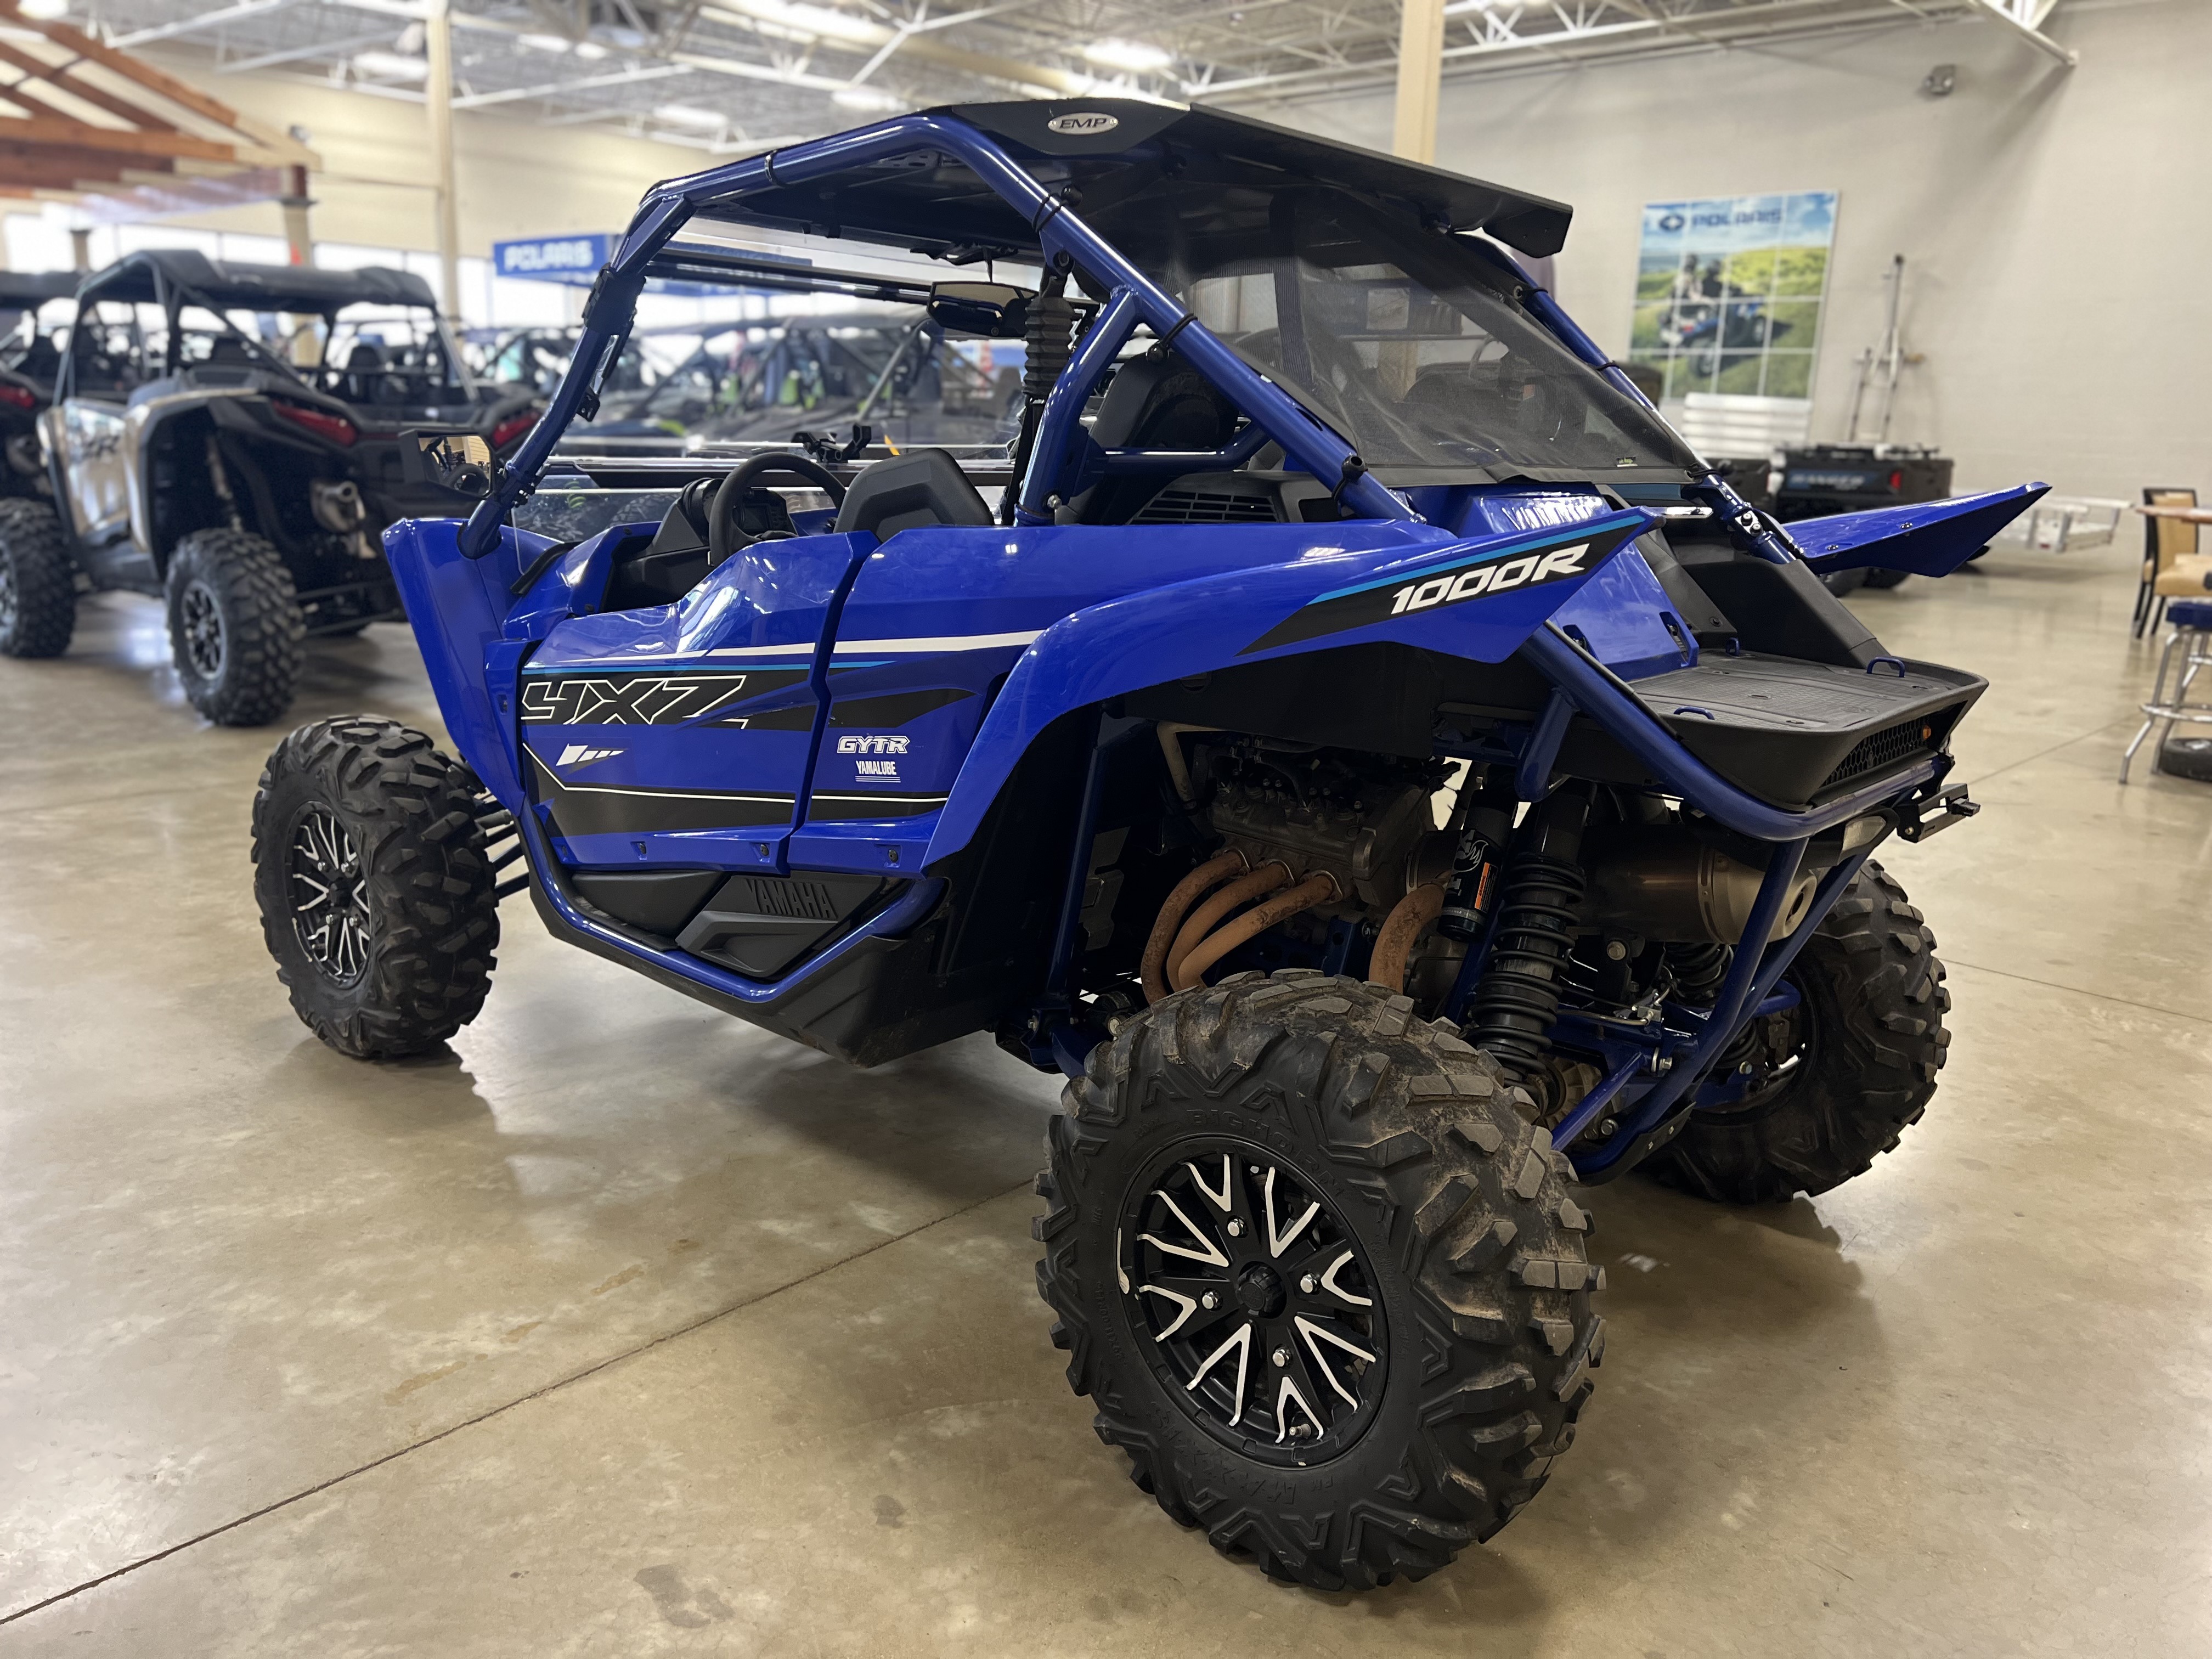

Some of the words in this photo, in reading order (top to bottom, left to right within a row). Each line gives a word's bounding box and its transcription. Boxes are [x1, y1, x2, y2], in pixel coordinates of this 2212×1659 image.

[1059, 117, 1107, 129] EMP
[1391, 544, 1589, 614] 1000R
[837, 736, 911, 754] GYTR
[856, 760, 897, 775] YAMALUBE
[746, 879, 838, 919] YAMAHA
[1186, 1108, 1346, 1197] BIGHORN
